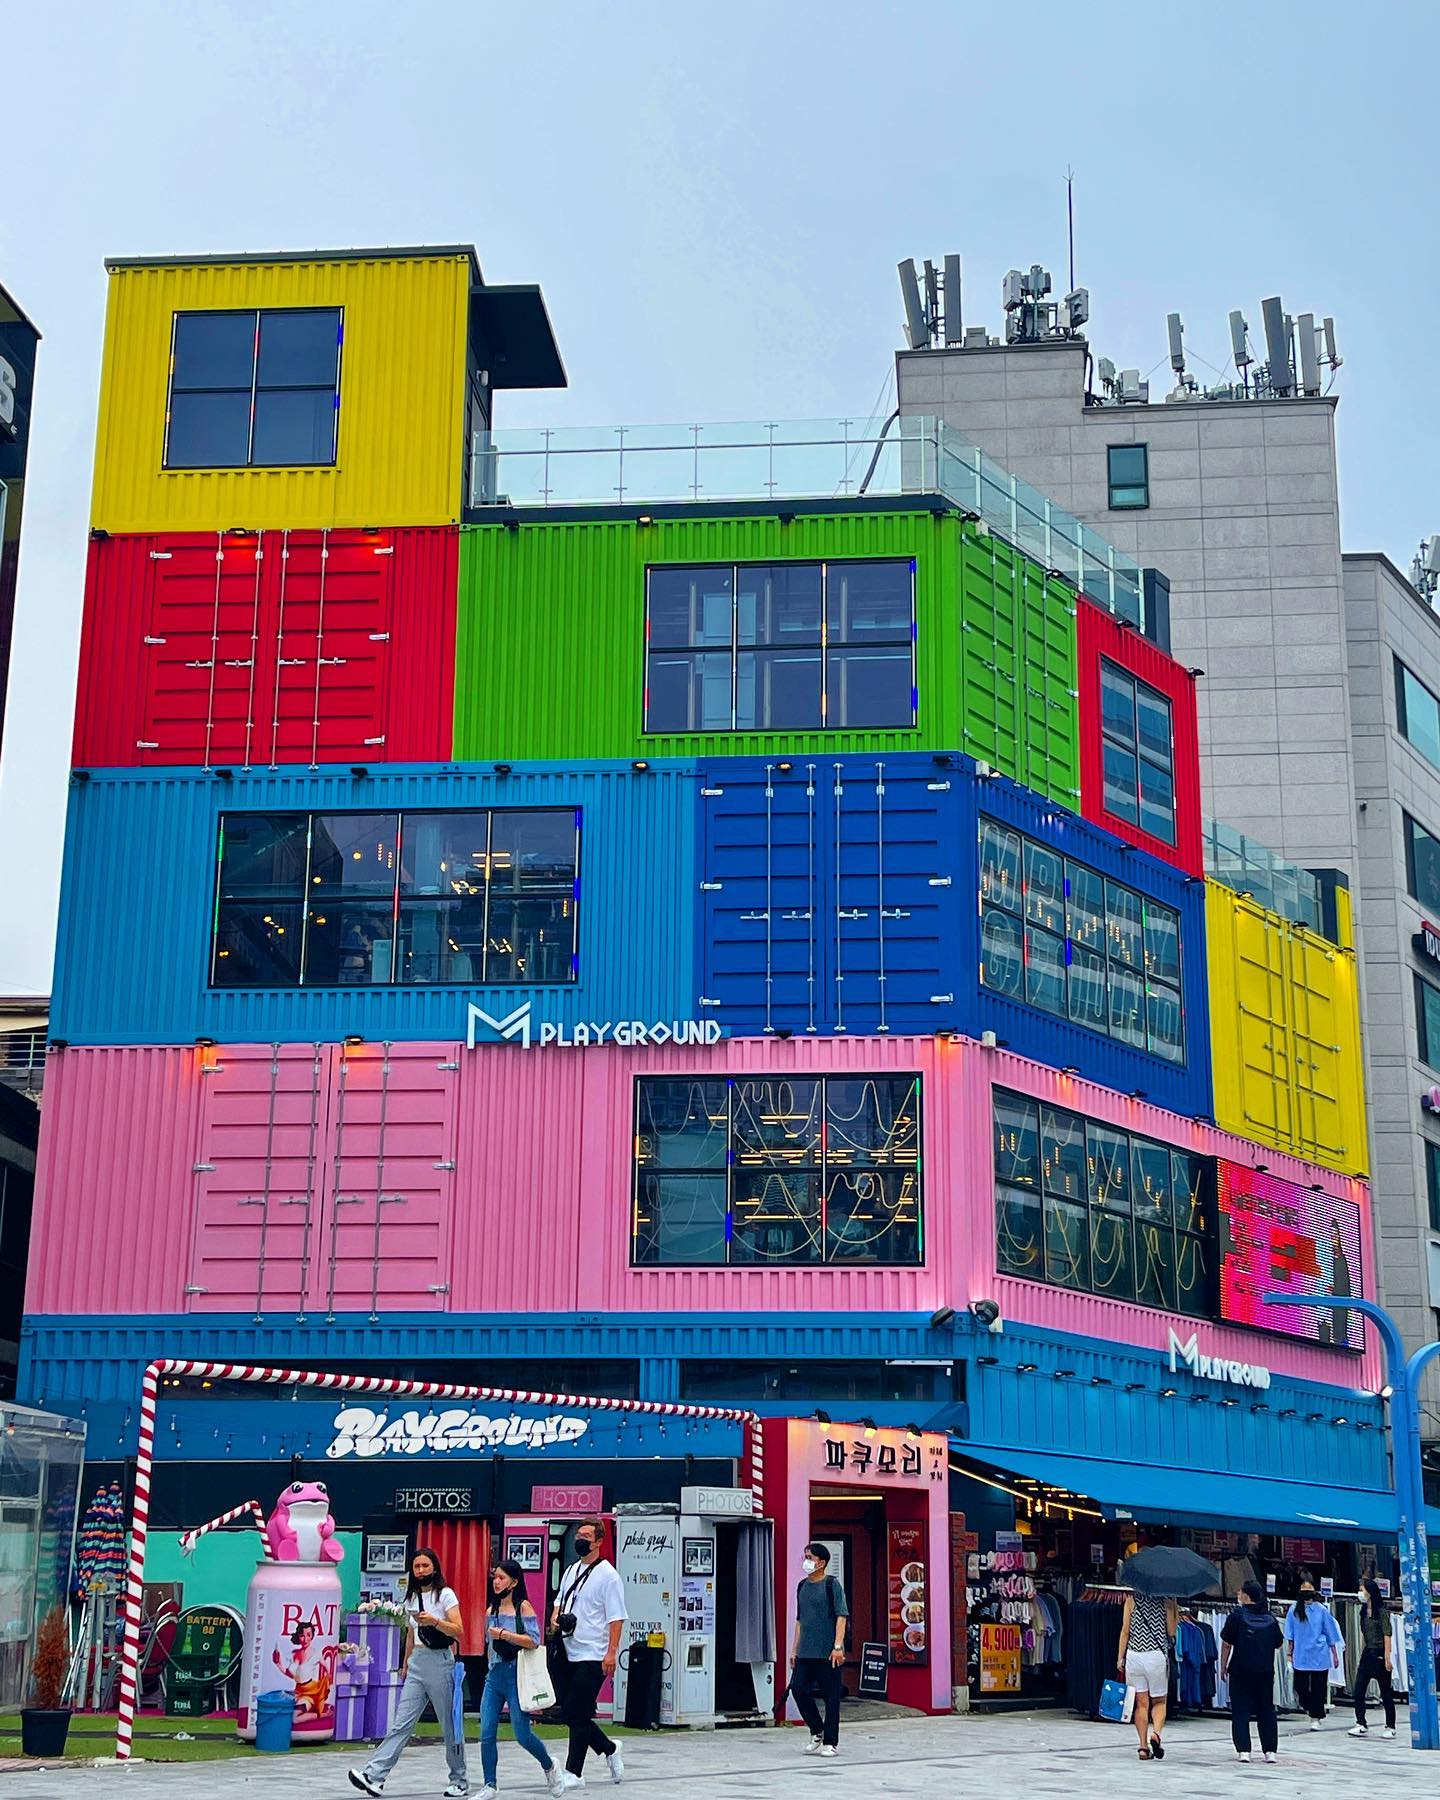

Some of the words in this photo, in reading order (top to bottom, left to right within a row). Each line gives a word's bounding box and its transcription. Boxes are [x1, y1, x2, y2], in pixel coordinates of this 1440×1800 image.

[540, 1020, 723, 1047] PLAYGROUND
[1199, 1354, 1271, 1390] PLAYGROUND
[326, 1407, 589, 1458] PLAYGROUND
[824, 1438, 922, 1476] 파쿠모리
[395, 1491, 472, 1509] PHOTOS
[698, 1491, 752, 1511] PHOTOS
[186, 1615, 233, 1627] BATTERY
